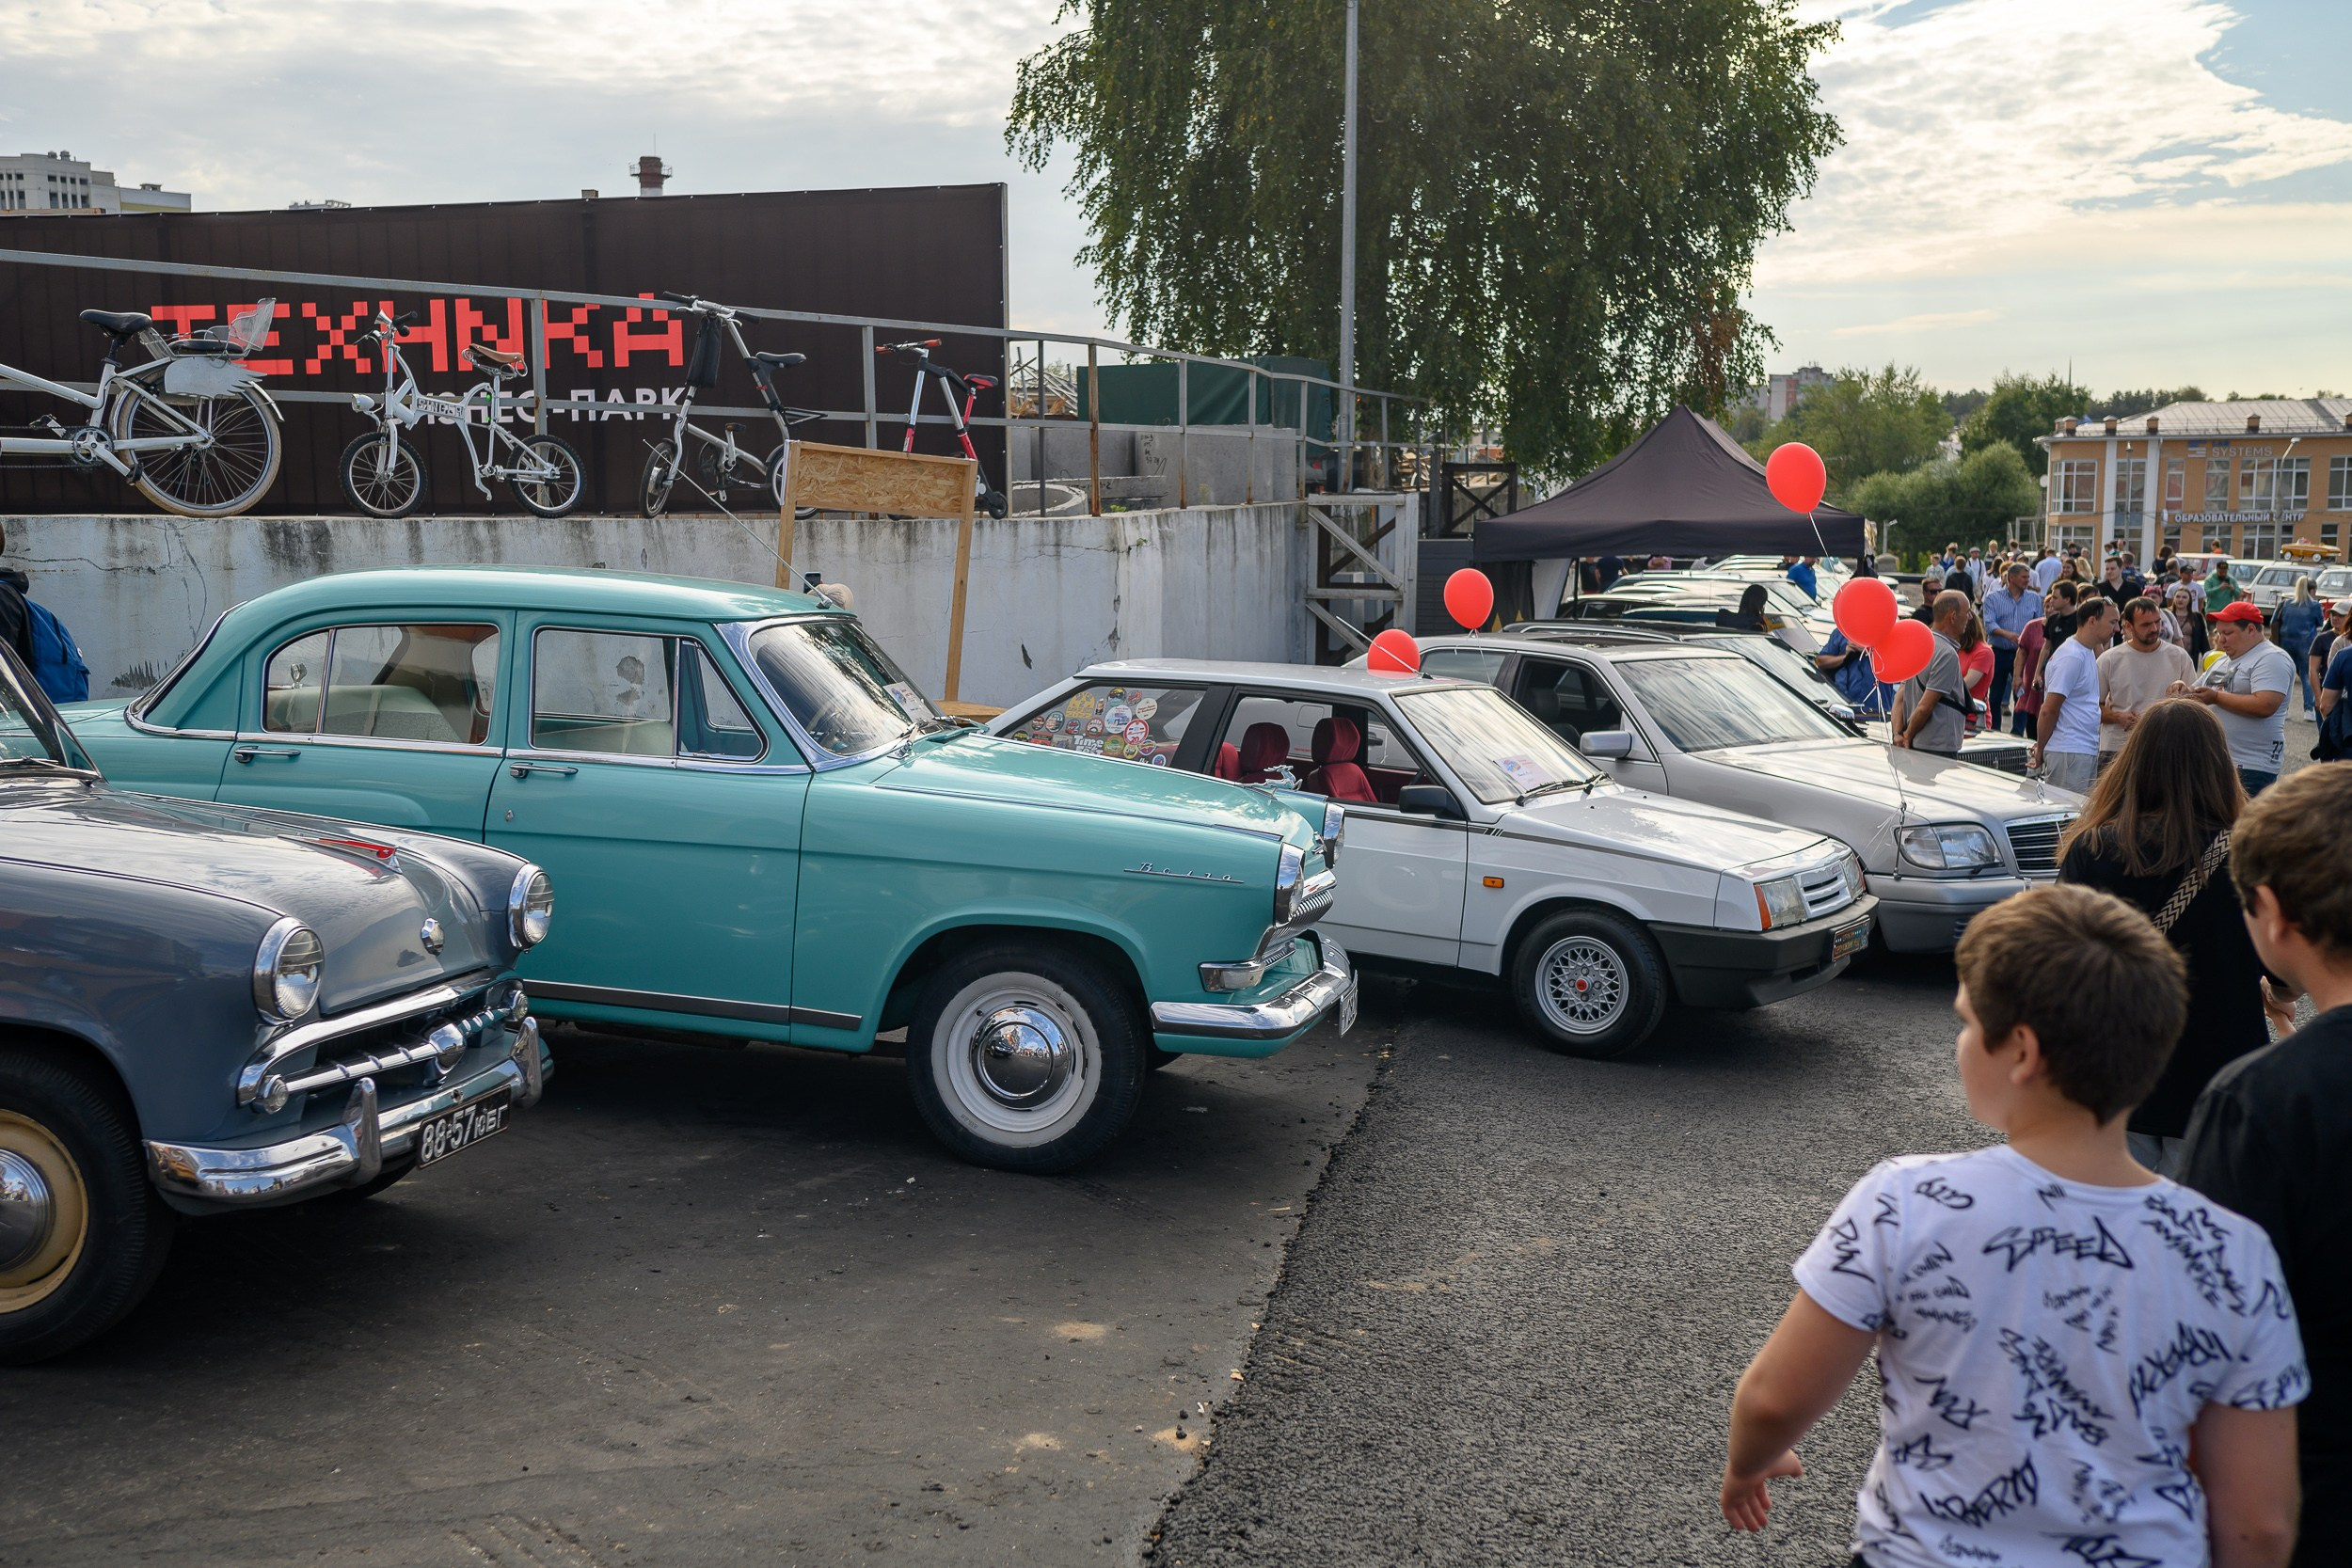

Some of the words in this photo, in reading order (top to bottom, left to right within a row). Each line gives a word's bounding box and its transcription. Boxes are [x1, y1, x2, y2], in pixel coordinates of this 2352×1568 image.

[388, 387, 686, 425] ЗНЕС-ПАРК
[2212, 446, 2273, 458] SYSTEMS
[2174, 511, 2270, 523] ОБРАЗОВАТЕЛЬНЫЙ
[1138, 862, 1232, 880] Волга
[1982, 1213, 2135, 1273] SPEED
